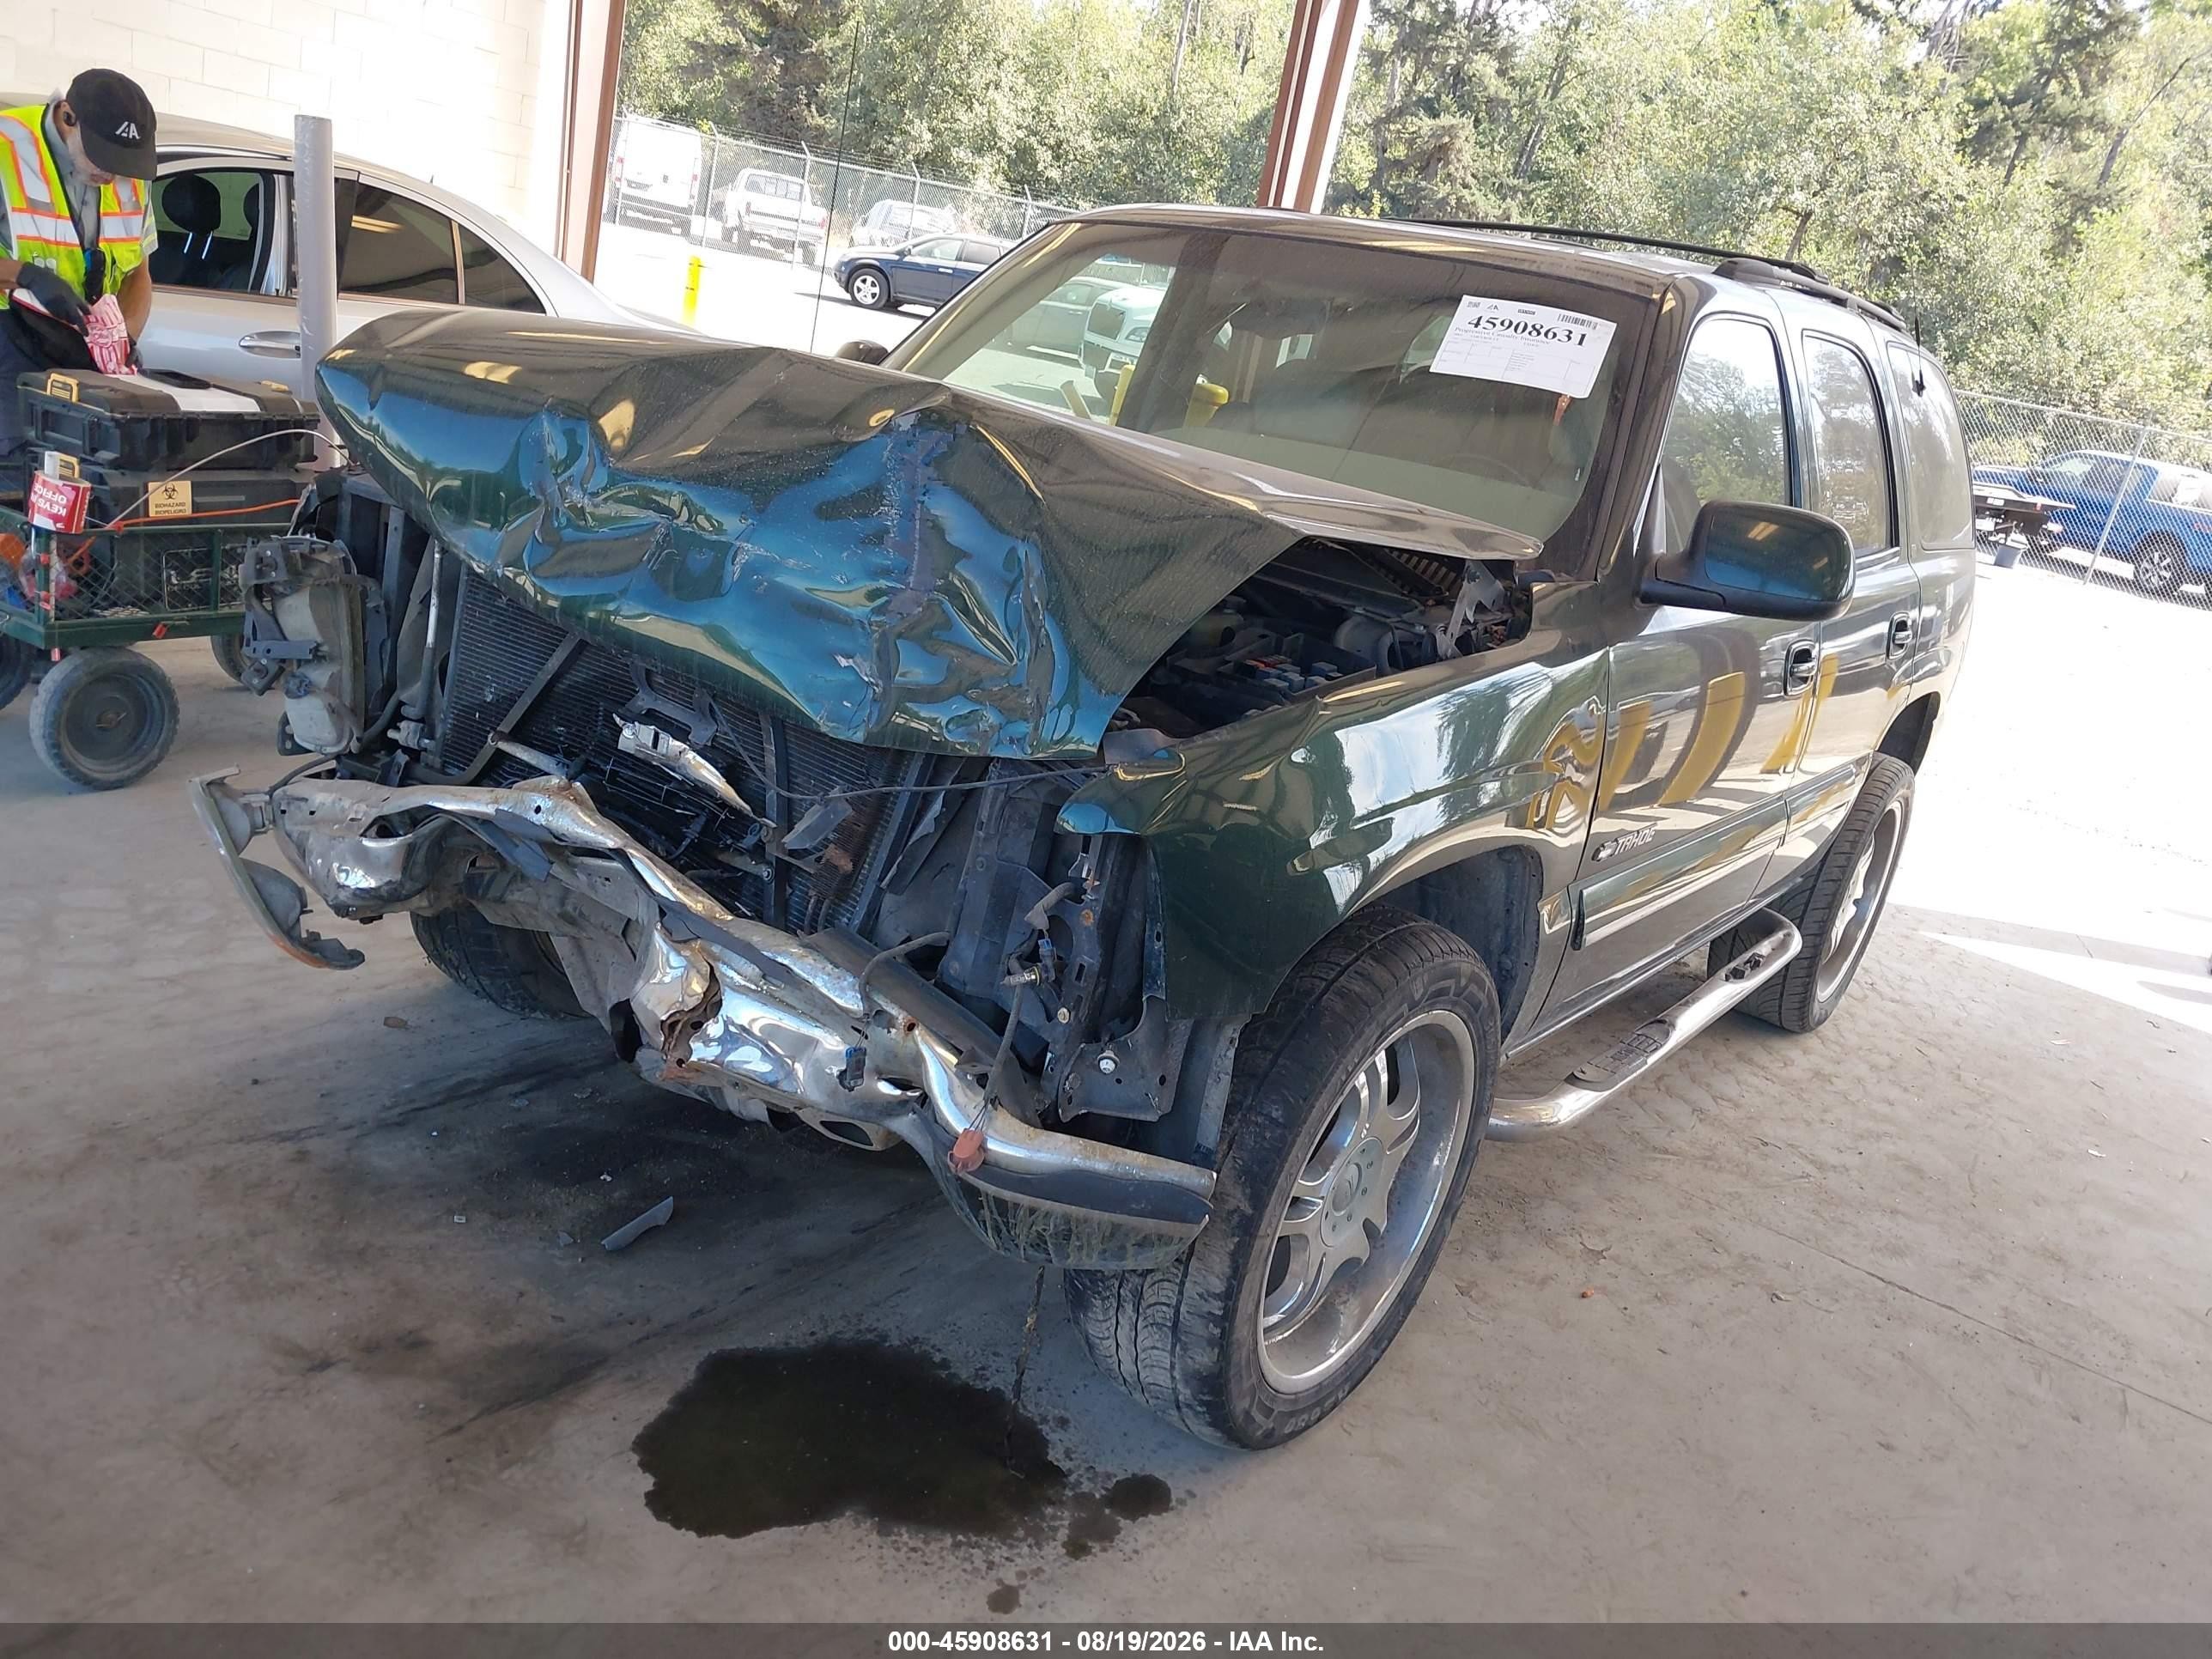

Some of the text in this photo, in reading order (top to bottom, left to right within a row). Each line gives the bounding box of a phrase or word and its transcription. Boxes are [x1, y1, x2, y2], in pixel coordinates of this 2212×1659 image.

[1468, 315, 1587, 347] 45908631
[38, 498, 67, 517] KEYS
[1614, 828, 1656, 855] TAHOE
